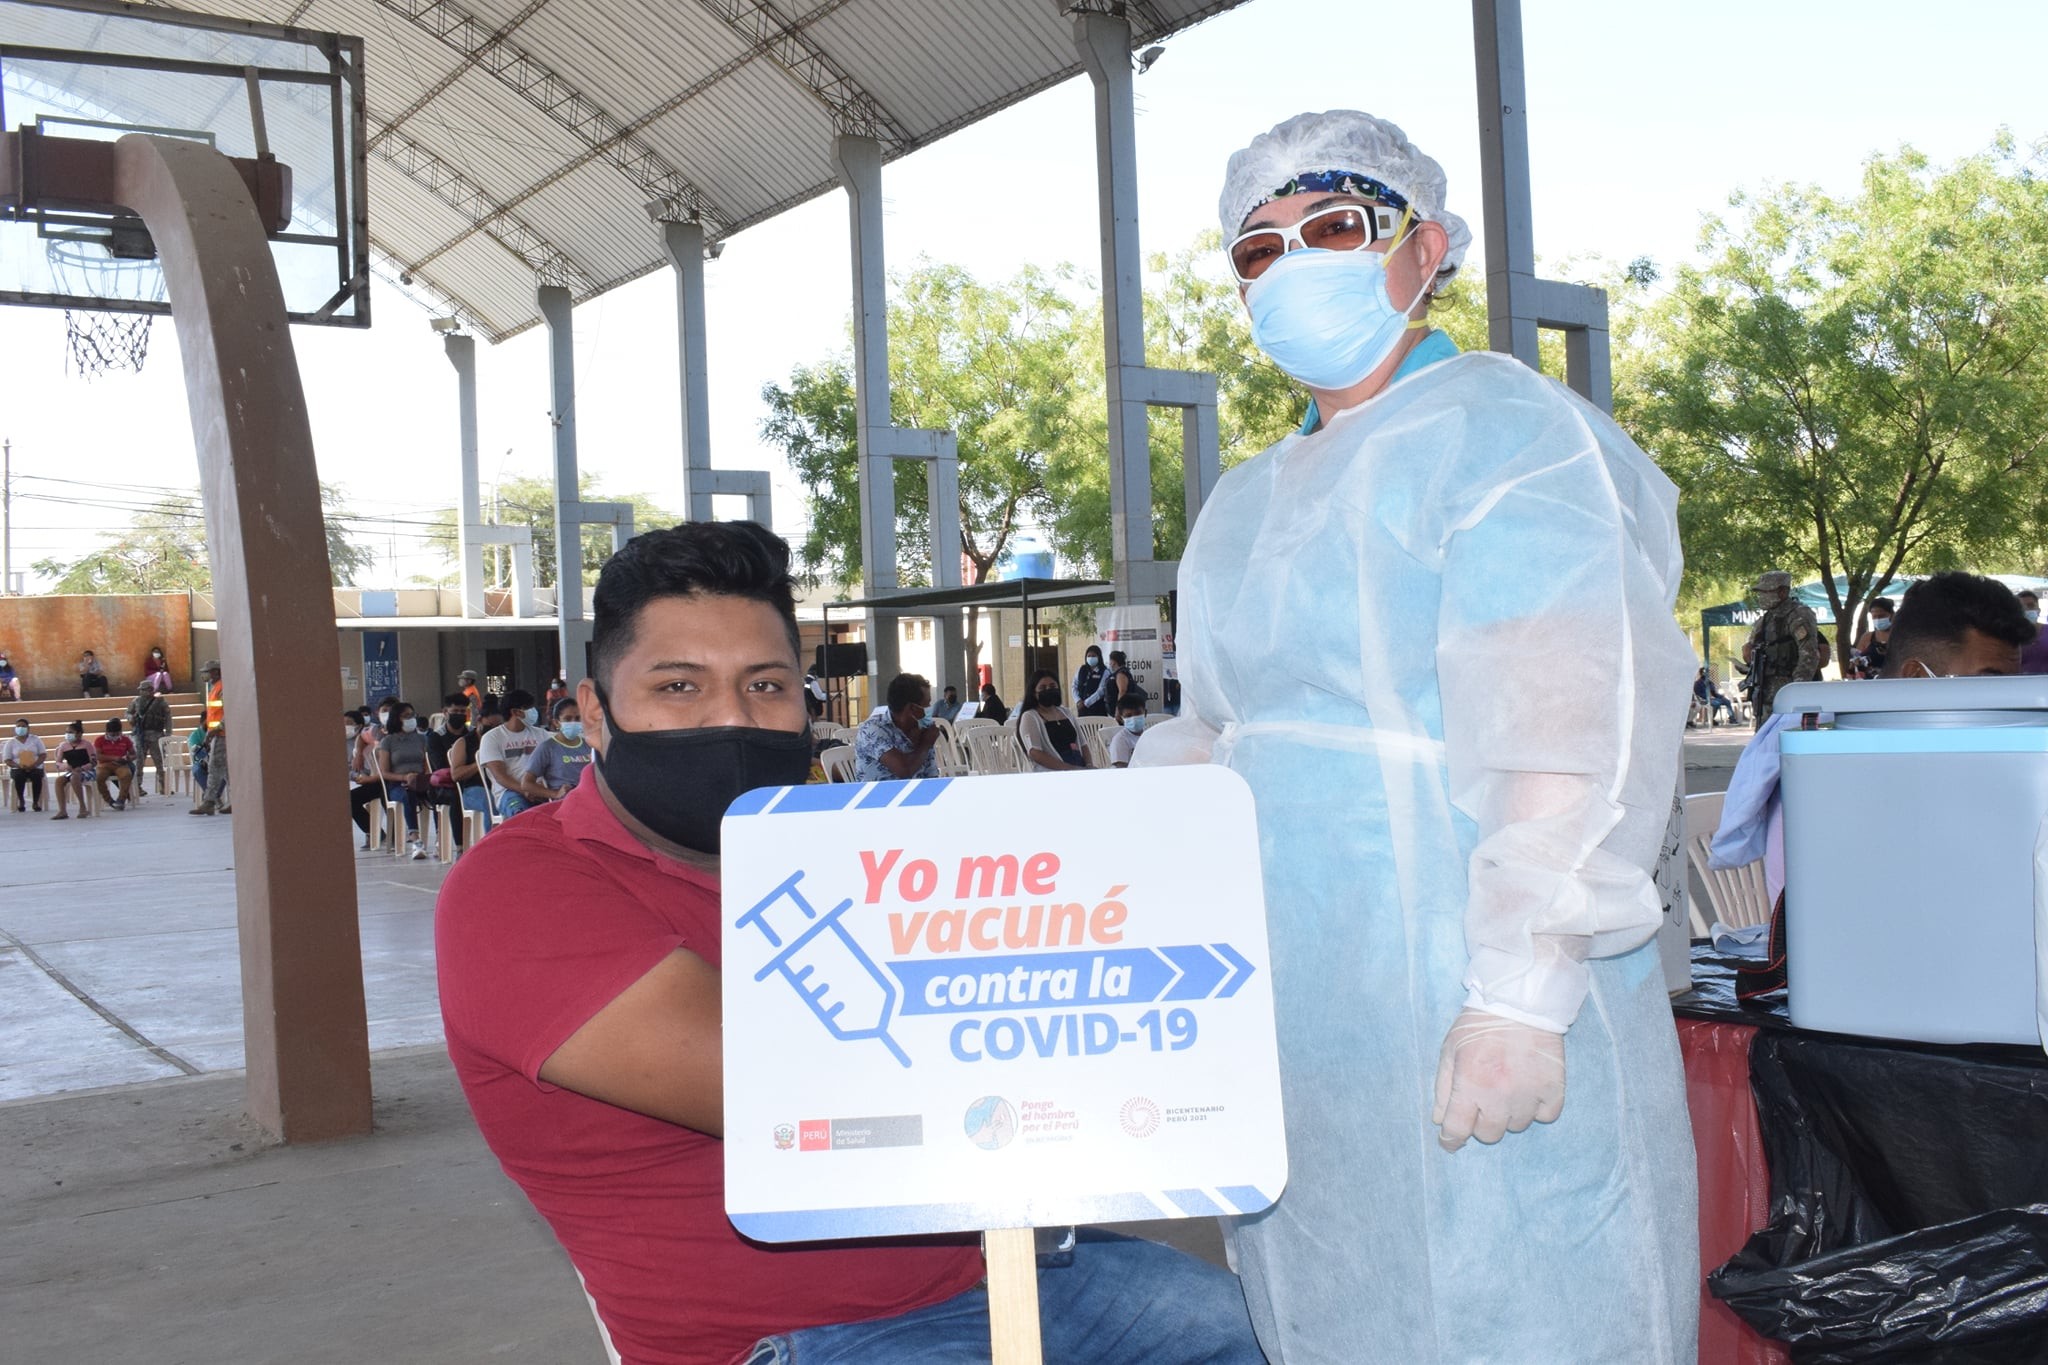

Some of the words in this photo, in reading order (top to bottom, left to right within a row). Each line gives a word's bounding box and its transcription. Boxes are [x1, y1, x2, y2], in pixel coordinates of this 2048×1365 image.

[1123, 659, 1152, 671] EGIÓN
[859, 849, 938, 904] Yo
[955, 852, 1061, 900] me
[887, 885, 1129, 955] vacuné
[924, 966, 1078, 1008] contra
[1088, 957, 1132, 999] la
[949, 1007, 1199, 1063] COVID-19
[1021, 1100, 1054, 1111] Pongo
[1166, 1105, 1225, 1115] BICENTENARIO
[1021, 1111, 1032, 1120] el
[1034, 1109, 1076, 1120] hombro
[1166, 1114, 1187, 1123] PERÚ
[1190, 1114, 1208, 1122] 2021
[835, 1129, 872, 1137] Ministerio
[1022, 1123, 1040, 1135] por
[1042, 1121, 1053, 1131] el
[1054, 1119, 1080, 1131] Perú
[803, 1128, 827, 1141] PERÚ
[835, 1137, 846, 1145] de
[846, 1136, 866, 1145] Salud
